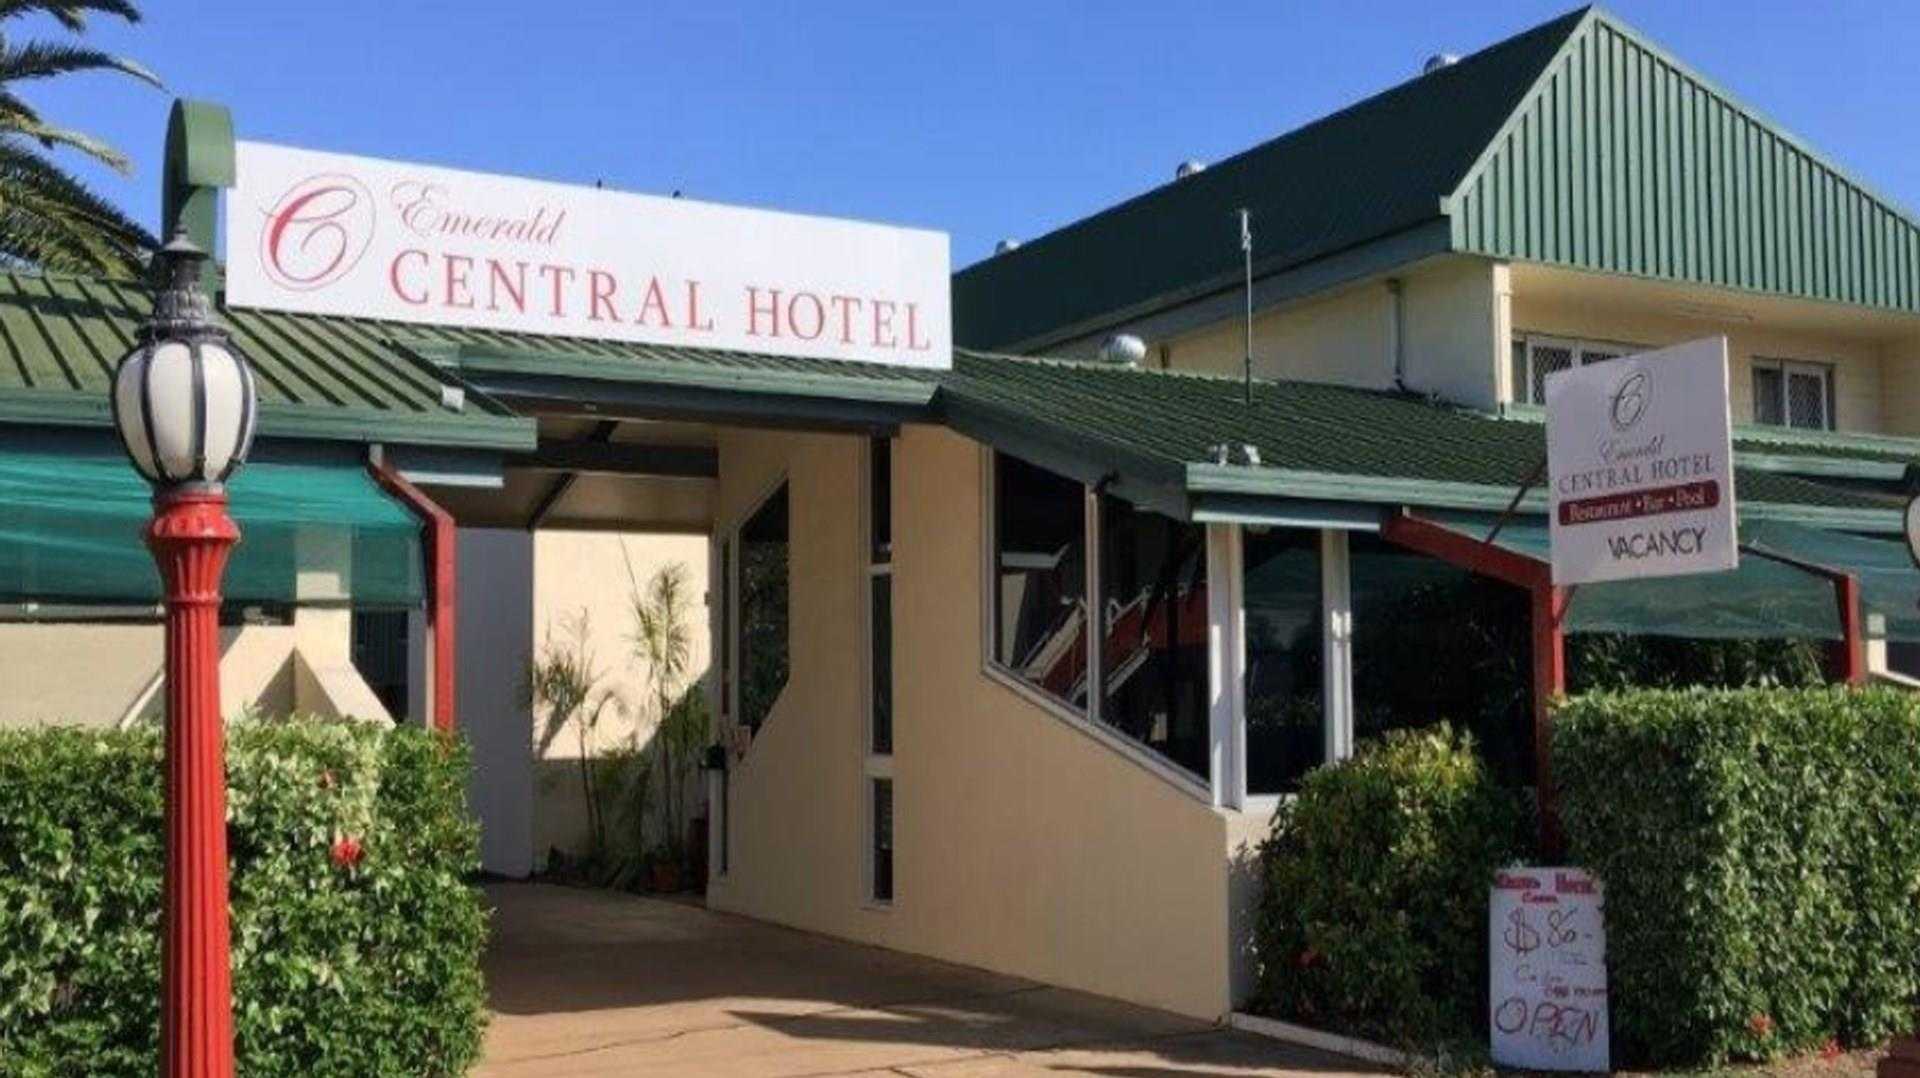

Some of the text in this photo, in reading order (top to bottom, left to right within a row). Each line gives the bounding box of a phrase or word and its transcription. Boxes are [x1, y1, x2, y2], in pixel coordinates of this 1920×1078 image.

[389, 179, 567, 246] Emerald
[389, 248, 931, 351] CENTRAL HOTEL
[1559, 455, 1714, 494] CENTRAL HOTEL
[1608, 528, 1706, 560] VACANCY
[1496, 998, 1598, 1047] OPEN
